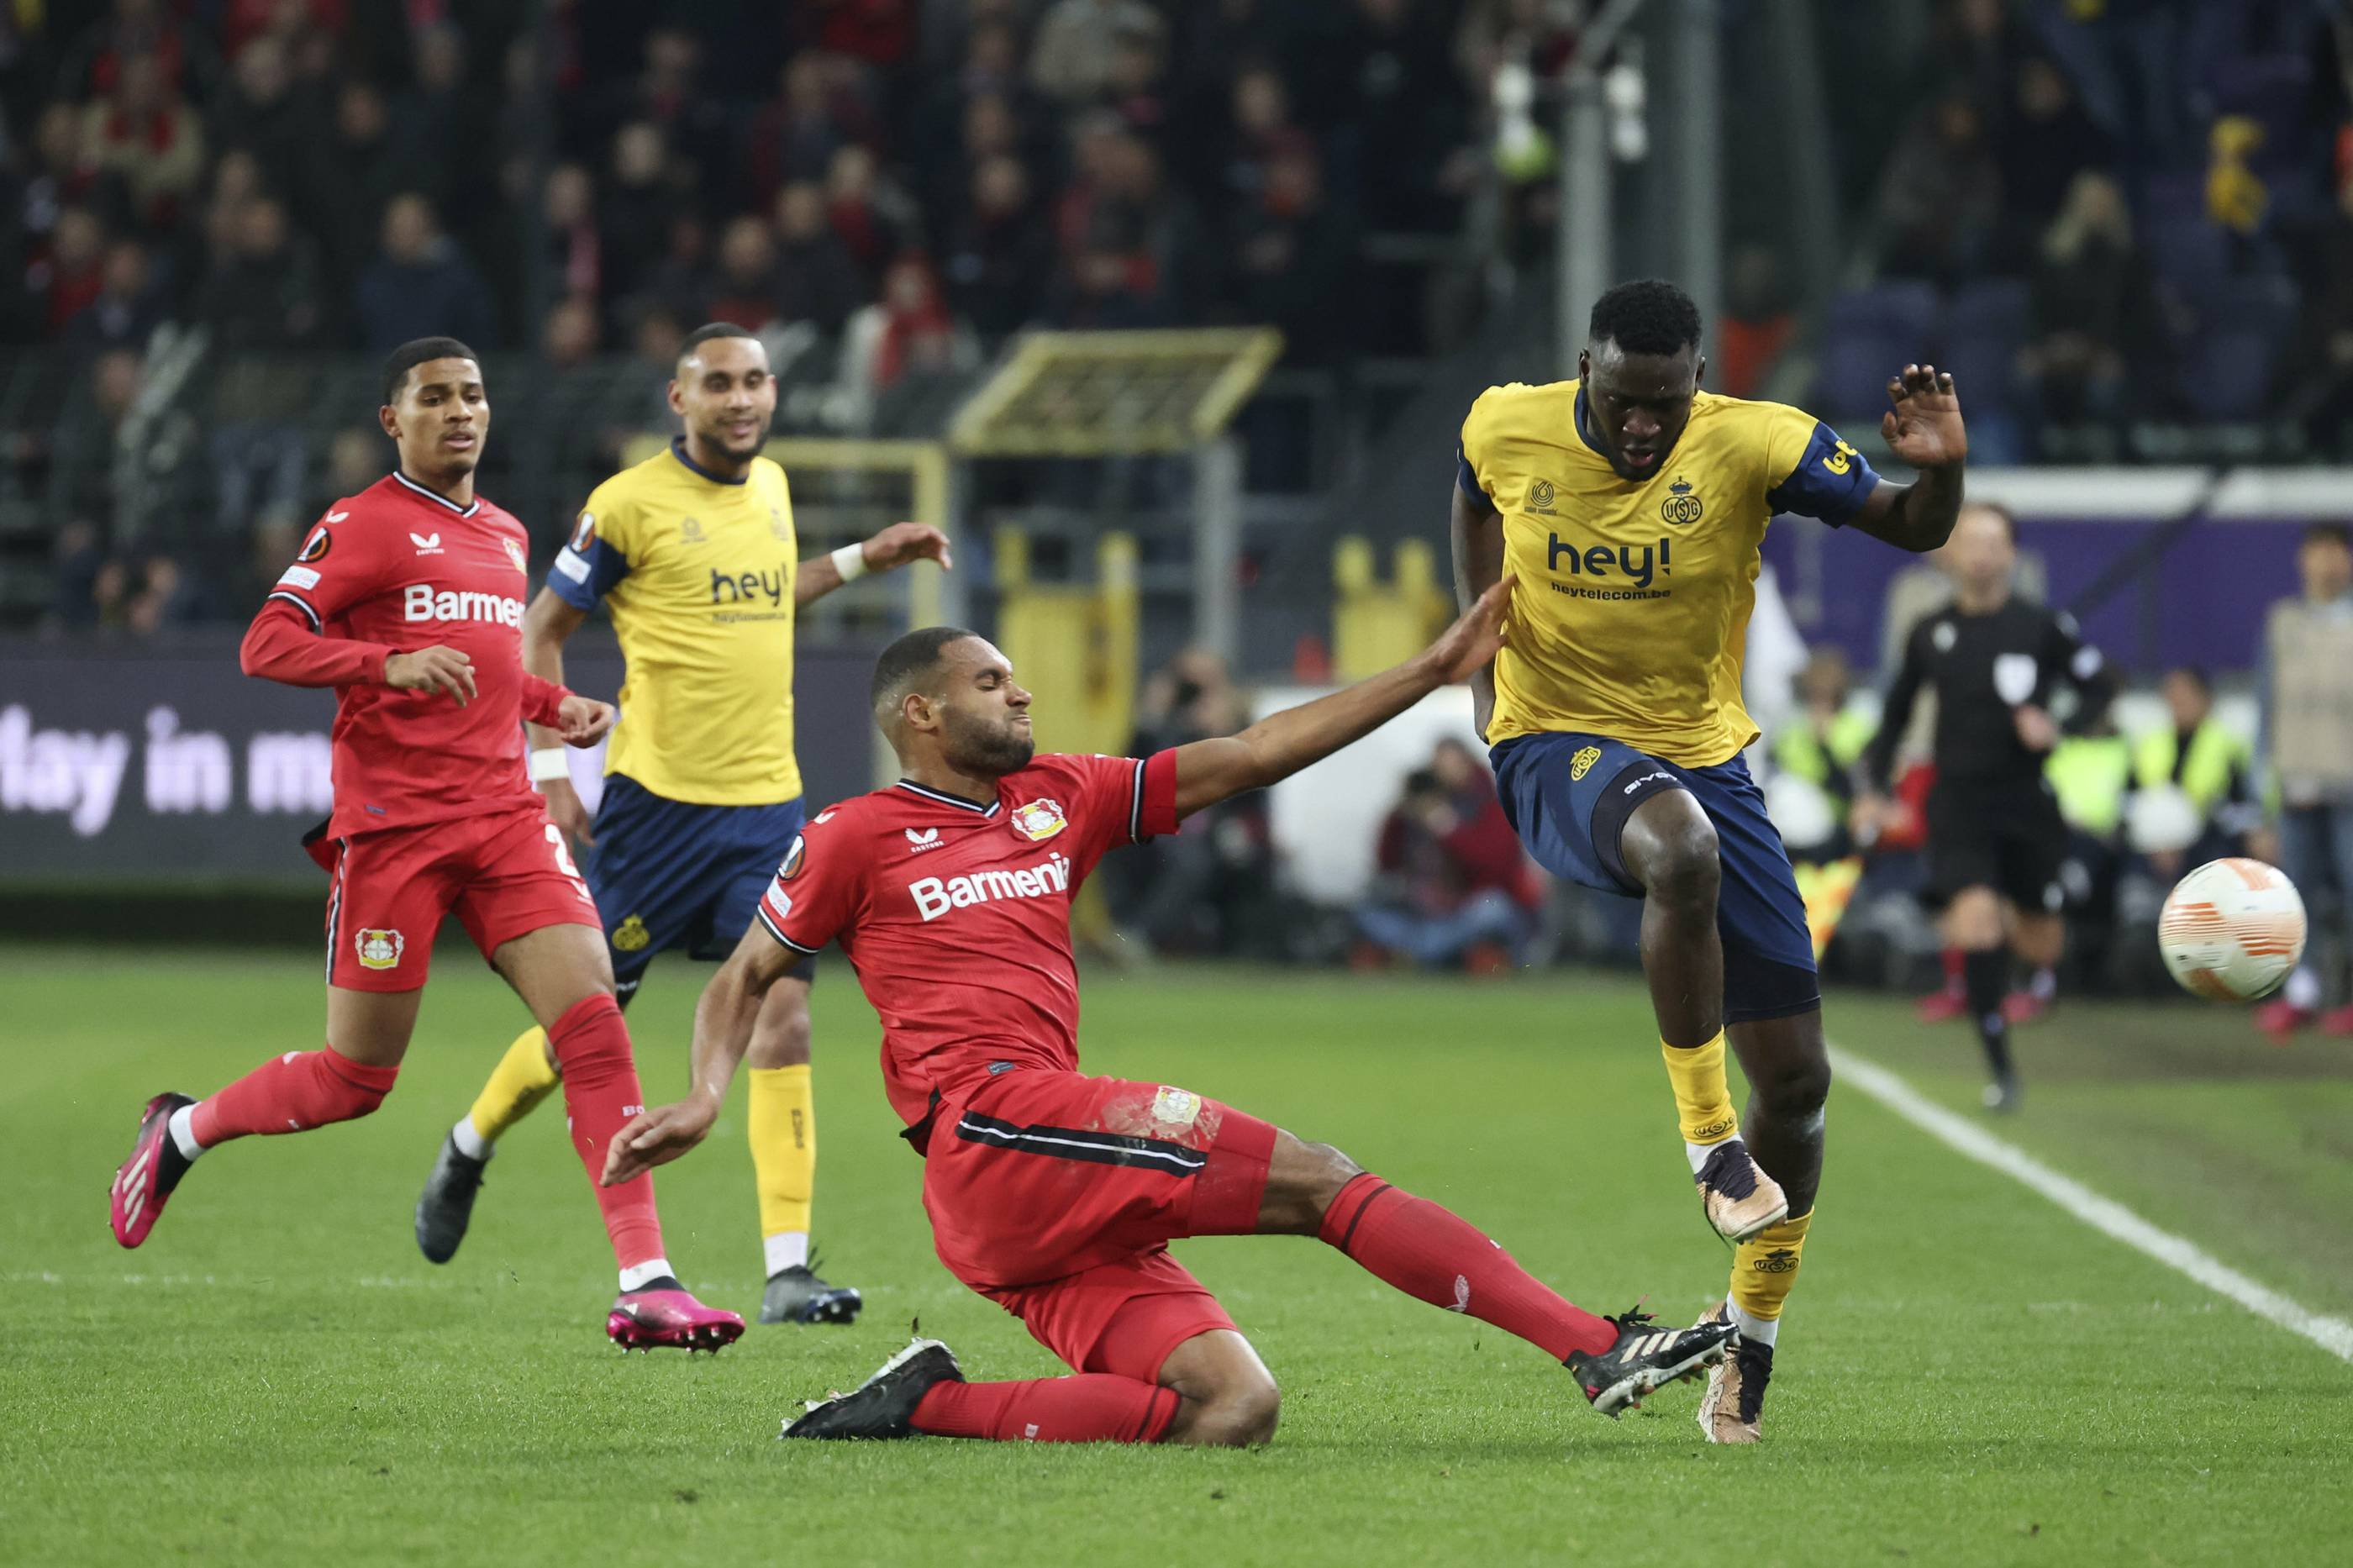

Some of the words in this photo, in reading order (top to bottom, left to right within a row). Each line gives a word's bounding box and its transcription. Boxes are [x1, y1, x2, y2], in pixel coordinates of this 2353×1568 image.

[1548, 532, 1671, 588] hey!
[1551, 581, 1671, 601] heytelecom.be
[145, 706, 232, 813] in
